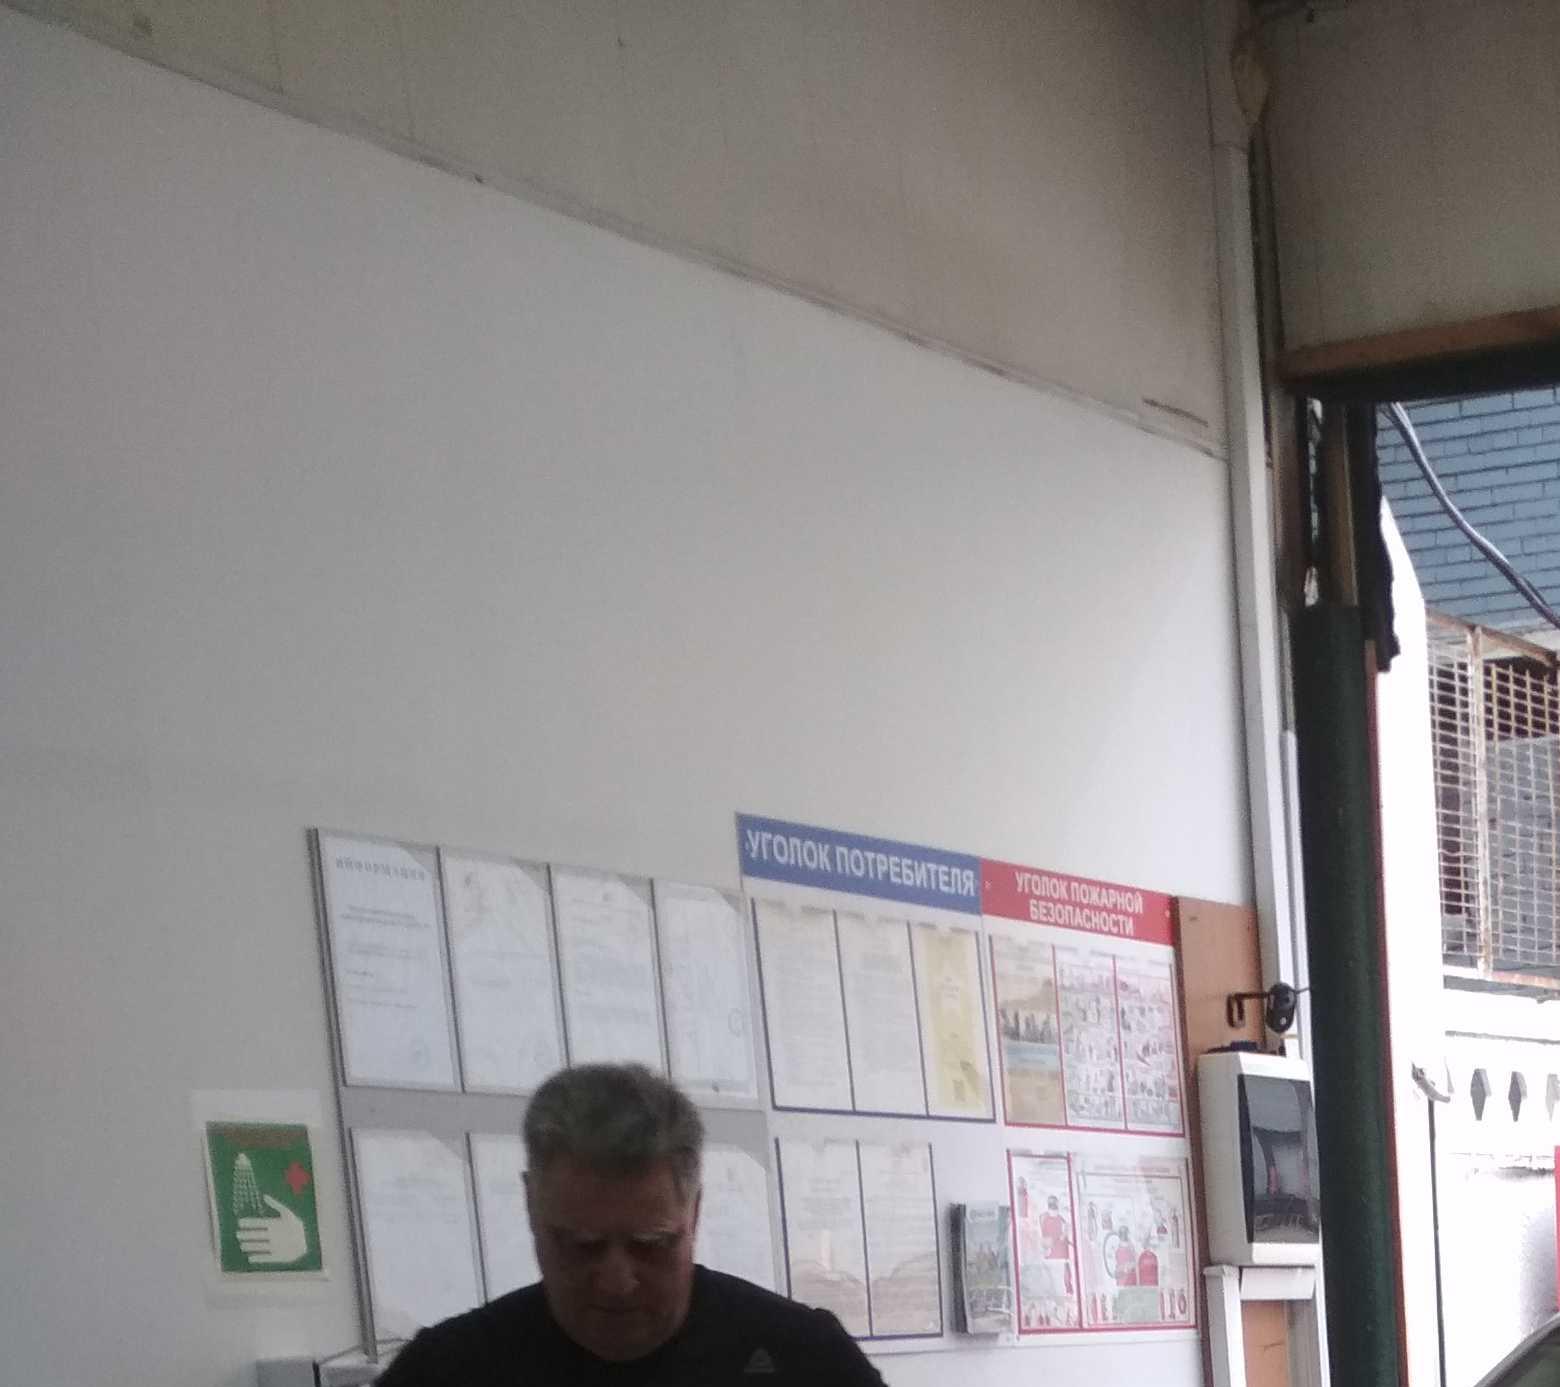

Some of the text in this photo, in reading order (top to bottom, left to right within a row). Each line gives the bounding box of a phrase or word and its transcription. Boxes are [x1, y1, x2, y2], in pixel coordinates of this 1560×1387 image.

[746, 829, 976, 897] УГОЛОК ПОТРЕБИТЕЛЯ
[1015, 871, 1144, 914] УГОЛОК ПОЖАРНОЙ
[1029, 900, 1135, 936] БЕЗОПАСНОСТИ
